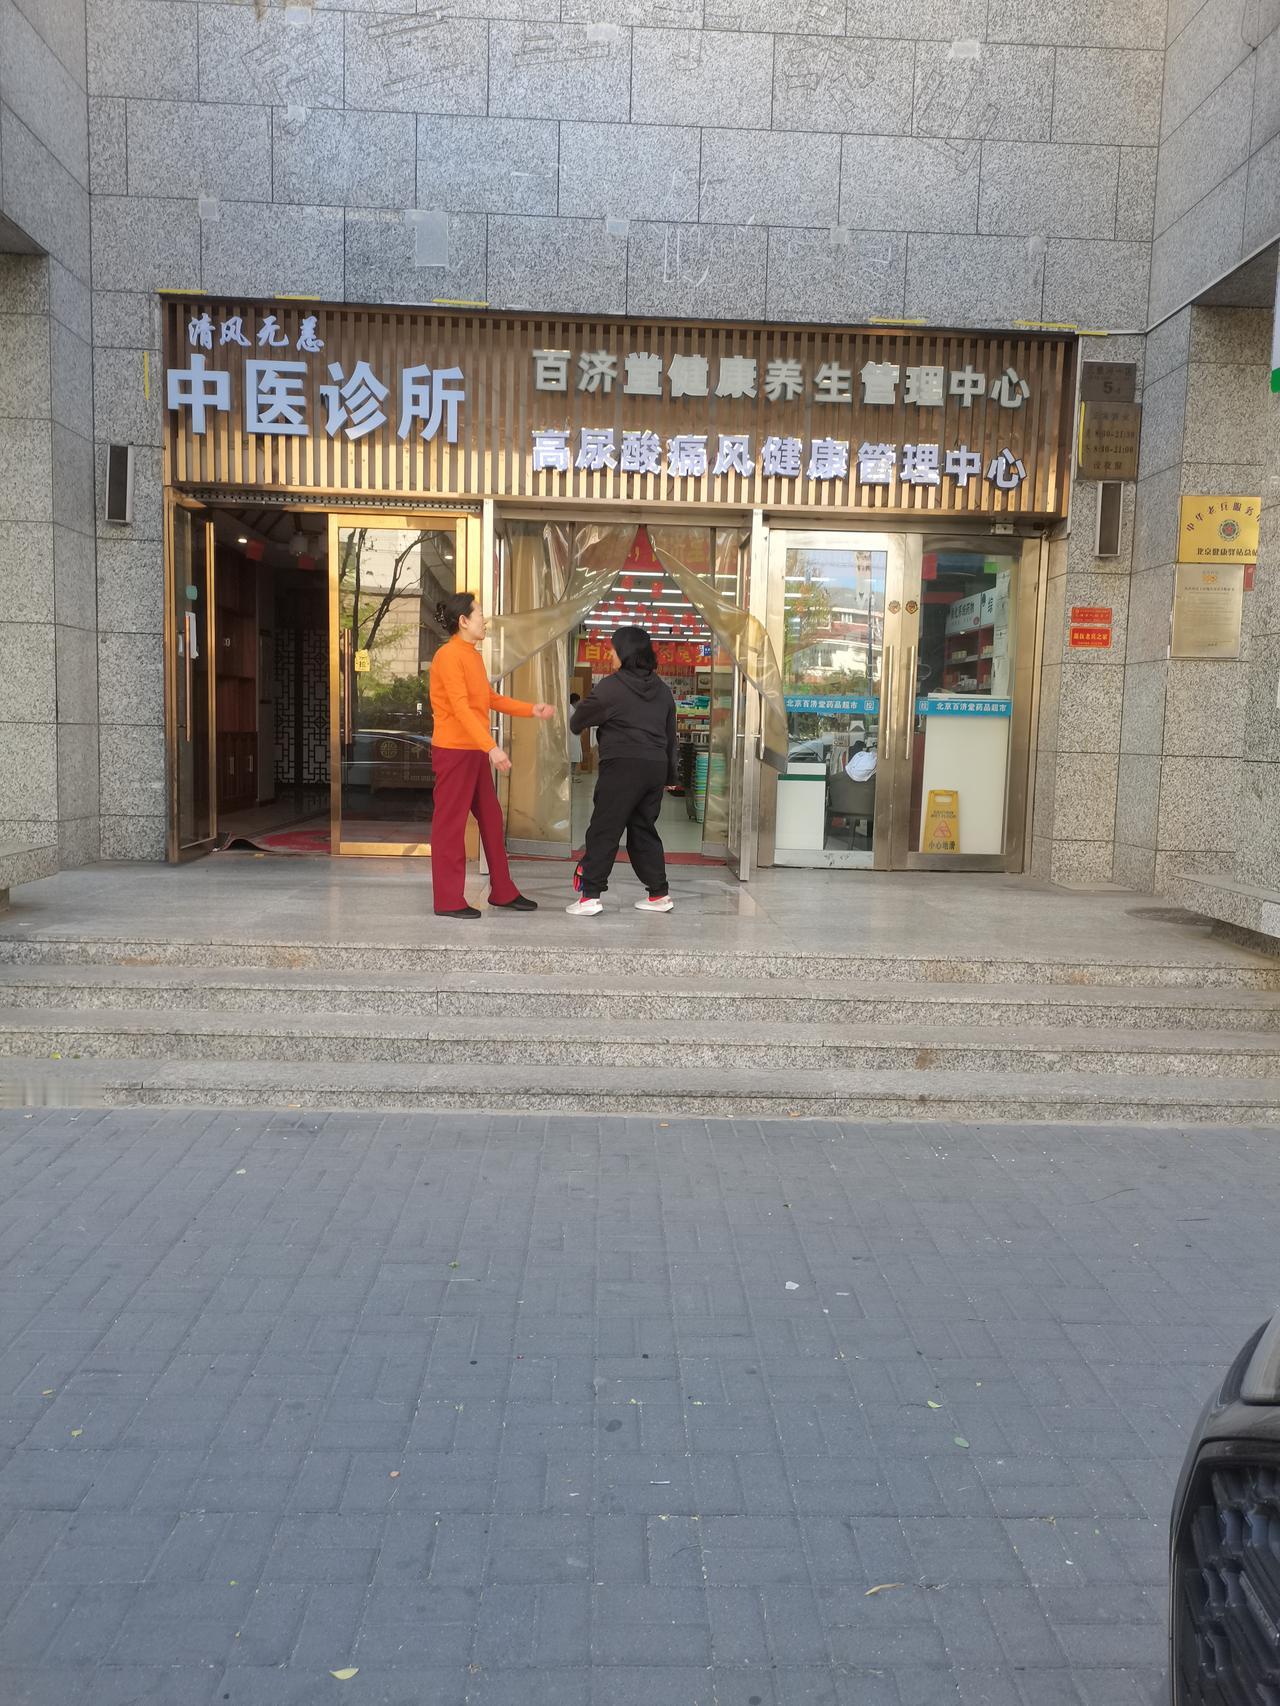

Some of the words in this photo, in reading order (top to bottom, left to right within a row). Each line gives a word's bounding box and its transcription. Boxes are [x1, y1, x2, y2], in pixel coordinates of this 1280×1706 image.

[167, 353, 465, 443] 中医诊所
[532, 349, 1030, 408] 百济堂健康养生管理中心
[532, 429, 1026, 489] 高尿酸痛风健康管理中心
[786, 698, 858, 710] 北京百济堂药品超市
[936, 702, 1007, 712] 北京百济堂药品超市
